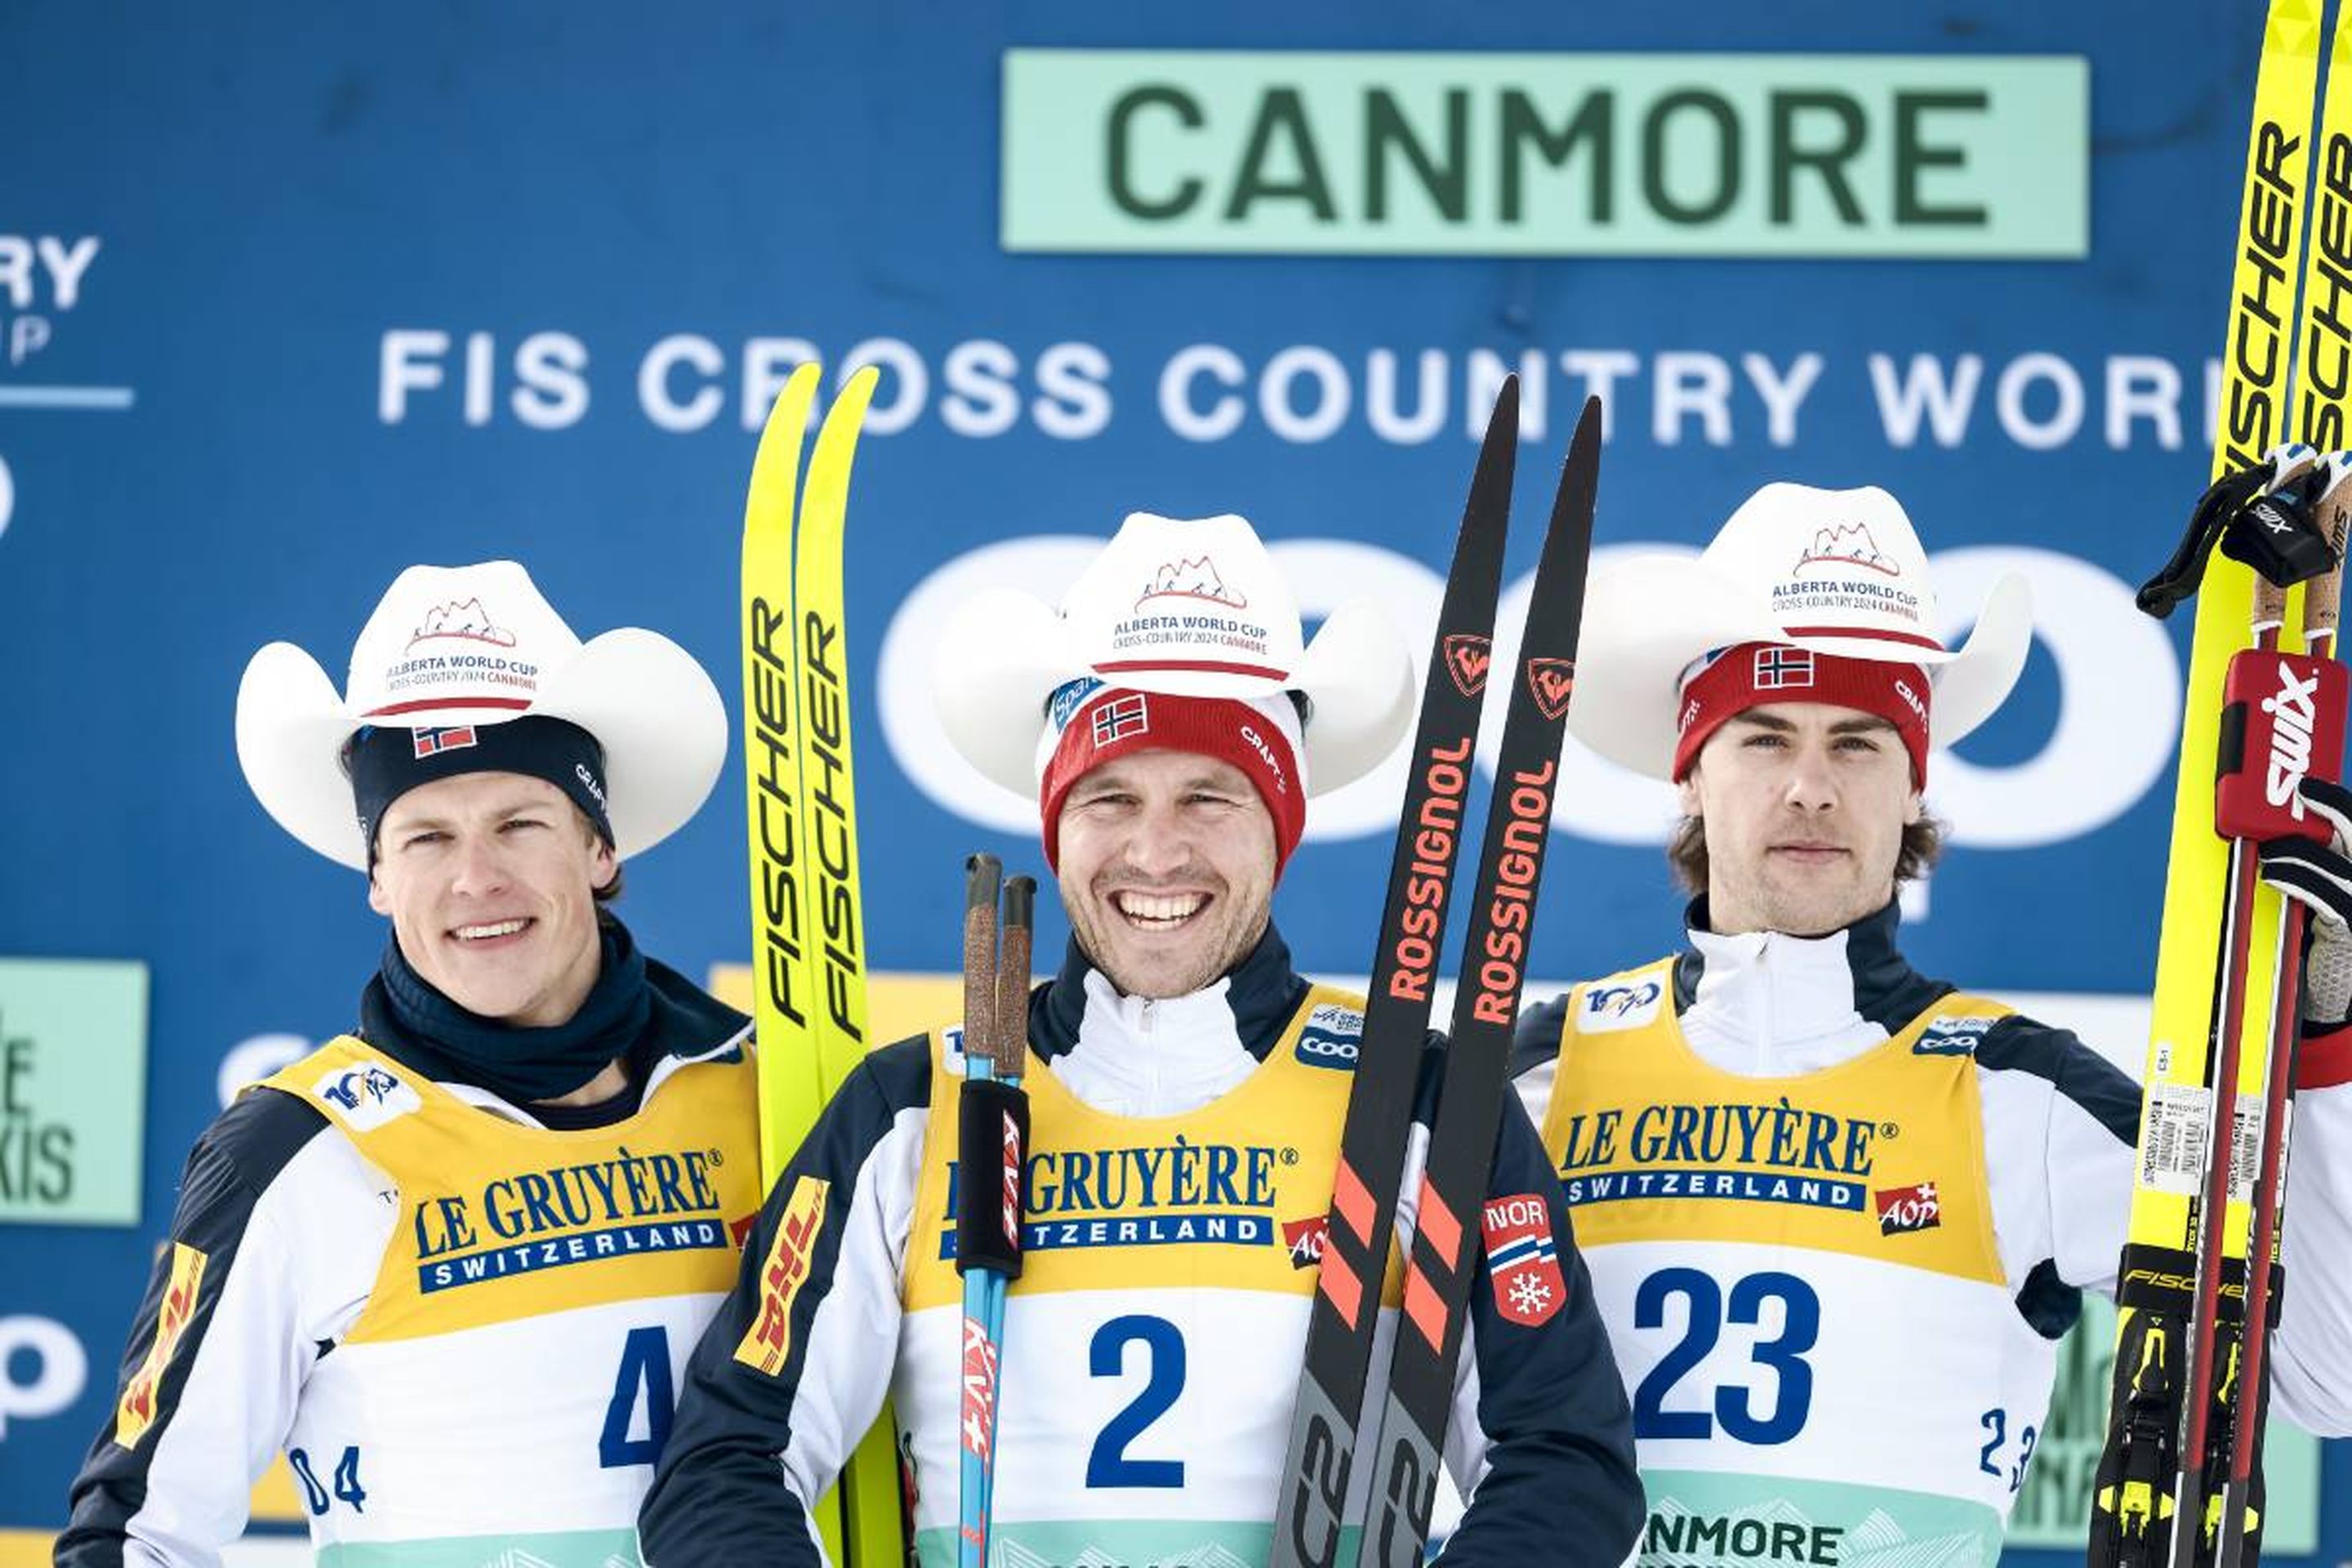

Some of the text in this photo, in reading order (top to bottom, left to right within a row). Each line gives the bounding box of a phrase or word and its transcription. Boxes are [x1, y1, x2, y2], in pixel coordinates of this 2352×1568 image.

[1102, 82, 1991, 227] CANMORE
[378, 330, 590, 430] FIS
[638, 333, 1114, 443] CROSS
[1158, 343, 1823, 447] COUNTRY
[1772, 581, 1918, 606] ALBERTA WORLD CUP
[1114, 616, 1267, 640] ALBERTA WORLD CUP
[1195, 633, 1219, 644] 2024
[450, 656, 507, 670] WORLD
[510, 662, 538, 675] CUP
[1239, 725, 1281, 777] CRAFT
[751, 595, 806, 1030] FISCHER
[805, 609, 863, 1043] FISCHER
[1390, 737, 1471, 1002] ROSSIGNOL
[1473, 760, 1554, 1026] ROSSIGNOL
[1560, 1108, 1622, 1171] LE
[1486, 1200, 1544, 1232] NOR
[1568, 1172, 1851, 1206] SWITZERLAND
[1881, 1200, 1940, 1230] AOP
[415, 1194, 477, 1259] LE
[434, 1223, 715, 1285] SWITZERLAND
[1290, 1228, 1330, 1259] AO
[755, 1205, 817, 1354] DHL
[1633, 1267, 1821, 1446] 23
[598, 1325, 675, 1477] 4
[1085, 1314, 1187, 1489] 2
[289, 1446, 367, 1516] 04
